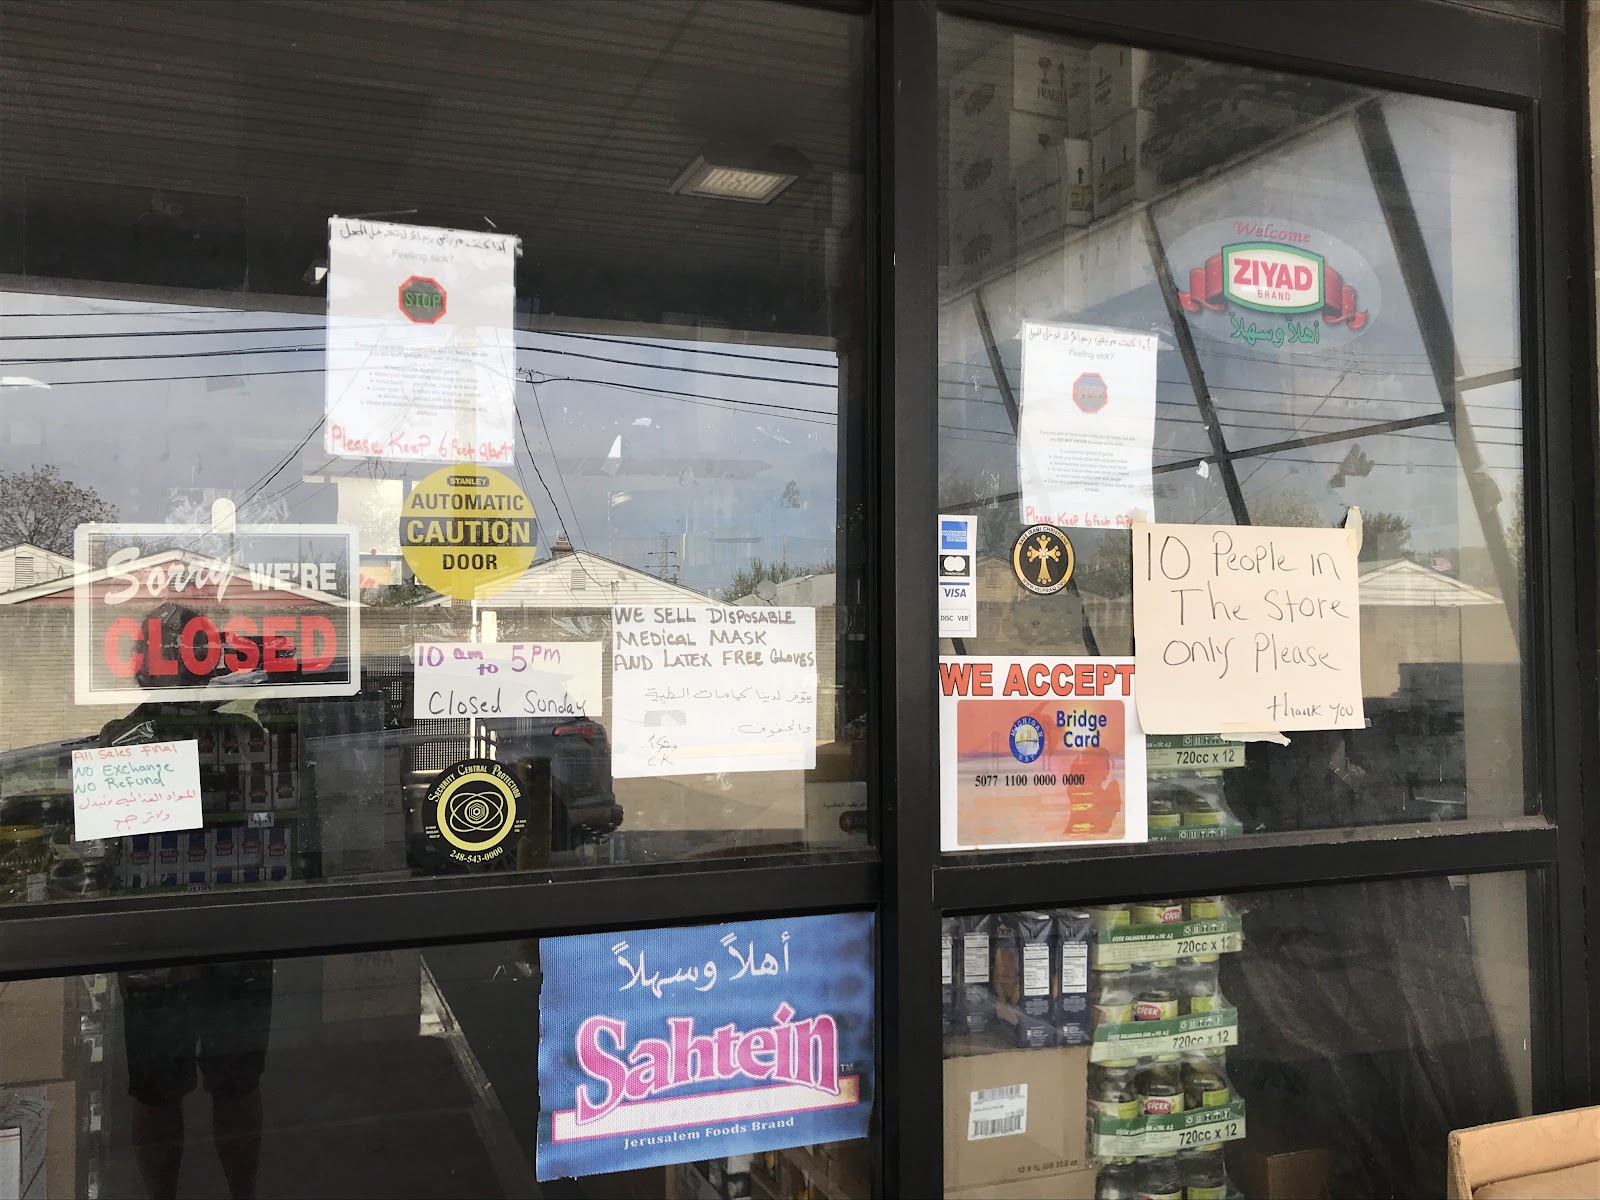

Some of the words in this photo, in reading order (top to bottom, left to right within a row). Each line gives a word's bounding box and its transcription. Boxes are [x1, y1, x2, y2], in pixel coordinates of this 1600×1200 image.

[1233, 221, 1311, 243] Welcome
[1233, 258, 1313, 291] ZIYAD
[404, 291, 442, 309] STOP
[1257, 289, 1291, 301] BRAND
[1068, 349, 1095, 360] Feeling
[438, 431, 448, 458] 6
[449, 478, 487, 486] STANLEY
[411, 493, 524, 511] AUTOMATIC
[1084, 511, 1092, 527] 6
[407, 520, 530, 543] CAUTION
[1018, 534, 1028, 546] SAVE
[1028, 526, 1042, 536] IRAQI
[1042, 526, 1069, 546] CHRISTIANS
[442, 553, 498, 570] DOOR
[1147, 532, 1191, 582] 10
[104, 547, 235, 605] Sorry
[249, 562, 337, 591] WE'RE
[944, 588, 967, 598] VISA
[1170, 580, 1249, 626] The
[1264, 589, 1351, 623] Store
[614, 607, 645, 625] WE
[654, 607, 697, 624] SELL
[104, 615, 338, 679] CLOSED
[709, 629, 768, 646] MASK
[418, 645, 445, 667] 10
[453, 648, 484, 660] am
[476, 663, 499, 676] to
[511, 644, 528, 673] 5
[614, 654, 653, 671] AND
[664, 649, 713, 668] LATEX
[722, 649, 764, 667] FREE
[1253, 632, 1343, 673] Please
[938, 662, 994, 697] WE
[1002, 663, 1136, 697] ACCEPT
[428, 687, 502, 716] Closed
[523, 689, 587, 717] Sunday
[1010, 717, 1044, 738] MICHIGAN
[1056, 710, 1107, 732] Bridge
[1063, 730, 1101, 749] Card
[74, 751, 93, 761] All
[98, 747, 132, 760] Sales
[1176, 750, 1209, 765] 720cc
[1212, 752, 1219, 763] x
[1222, 748, 1235, 763] 12
[74, 766, 94, 779] NO
[975, 774, 998, 788] 5077
[1004, 774, 1028, 787] 1100
[1033, 774, 1057, 787] 0000
[1062, 773, 1086, 786] 0000
[74, 782, 97, 794] NO
[428, 773, 456, 803] SECURITY
[457, 764, 488, 776] CENTRAL
[491, 764, 522, 799] PROTECTION
[449, 846, 504, 863] 248-543-0000
[1177, 939, 1208, 955] 720cc
[1211, 941, 1217, 951] x
[1216, 1029, 1229, 1044] 12
[575, 1000, 842, 1126] Sahtein
[840, 1063, 854, 1073] TM
[623, 1129, 701, 1150] Jerusalem
[704, 1123, 748, 1138] Foods
[751, 1116, 796, 1132] Brand
[1179, 1130, 1212, 1146] 720cc
[1214, 1129, 1222, 1139] x
[1225, 1123, 1238, 1137] 12
